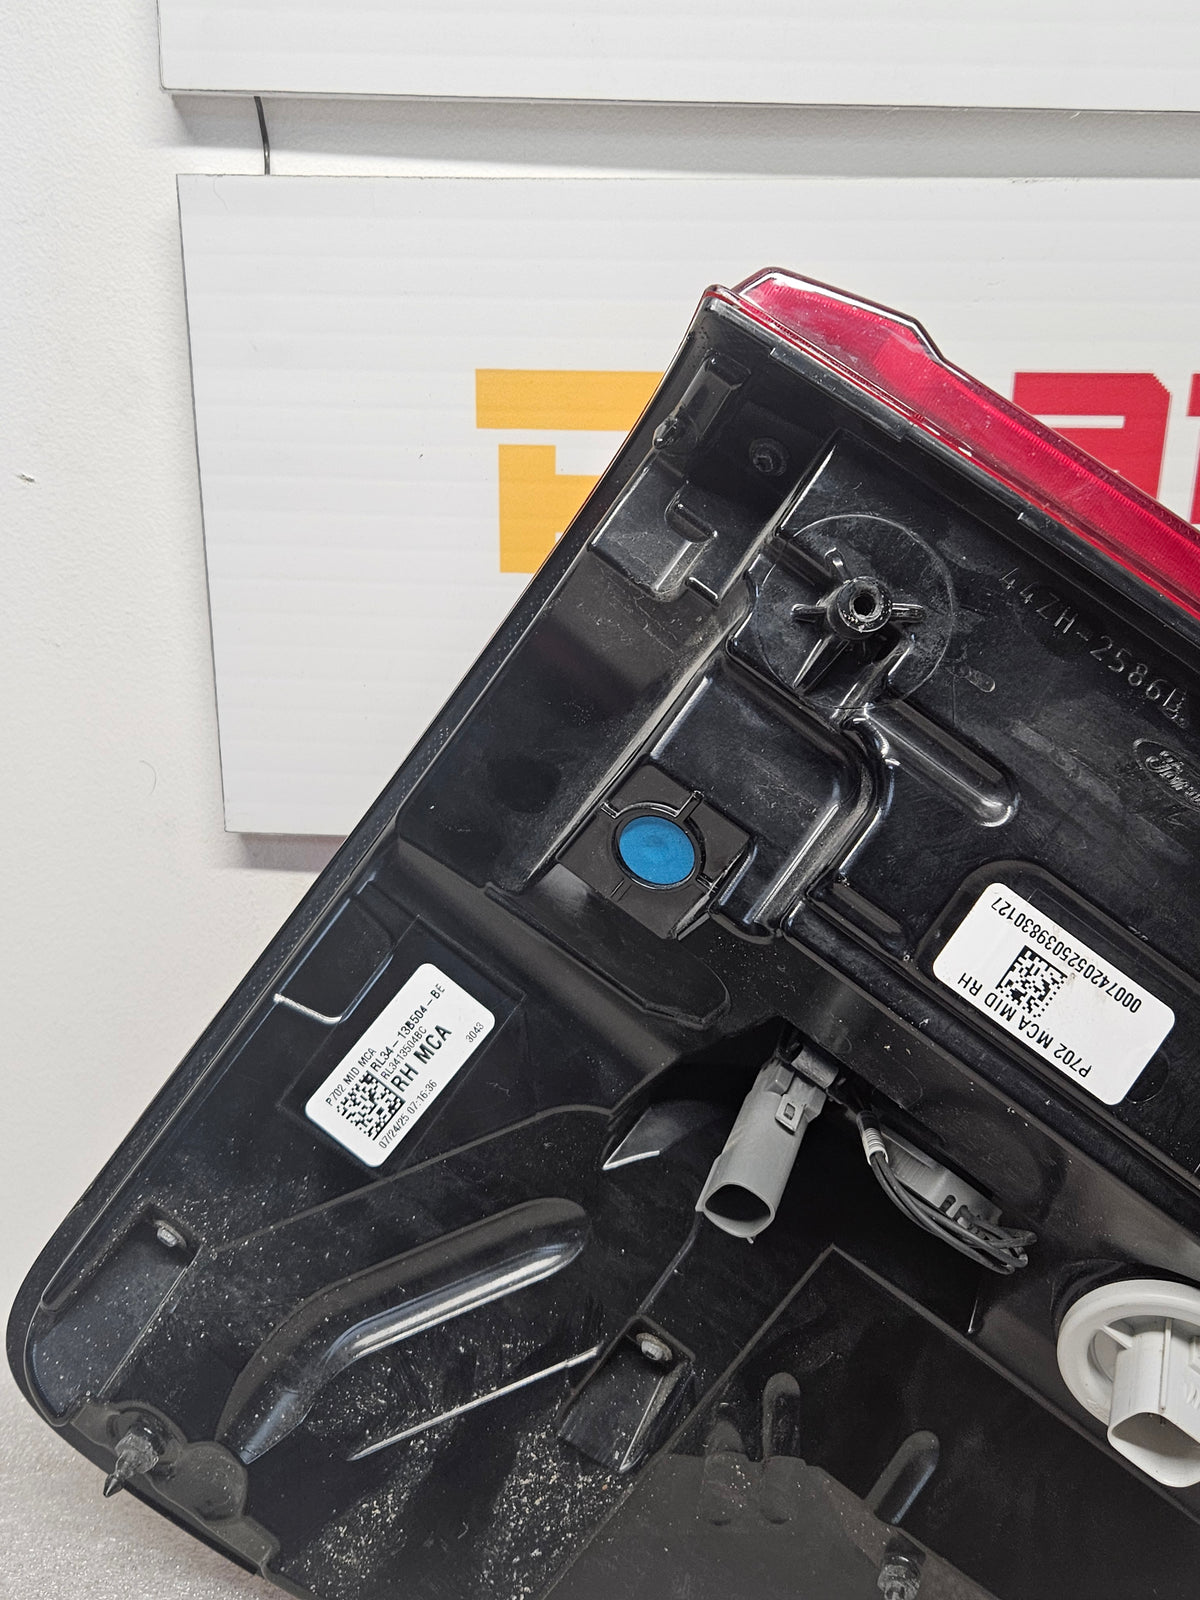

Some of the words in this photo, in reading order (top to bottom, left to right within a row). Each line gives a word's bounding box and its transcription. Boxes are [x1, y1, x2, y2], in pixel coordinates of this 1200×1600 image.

[991, 897, 1142, 1013] 0007420525039830127
[957, 972, 983, 996] RH
[985, 992, 1017, 1022] MID
[381, 1025, 428, 1080] RL3413504BC
[466, 1021, 485, 1043] 3043
[1018, 1015, 1053, 1049] MCA
[326, 1084, 346, 1106] P702
[344, 1068, 360, 1085] MID
[358, 1047, 377, 1068] MCA
[390, 1063, 419, 1093] RH
[413, 1024, 452, 1065] MCA
[1054, 1043, 1092, 1077] P702
[379, 1115, 410, 1149] 07/24/25
[407, 1079, 438, 1114] 07:16:36
